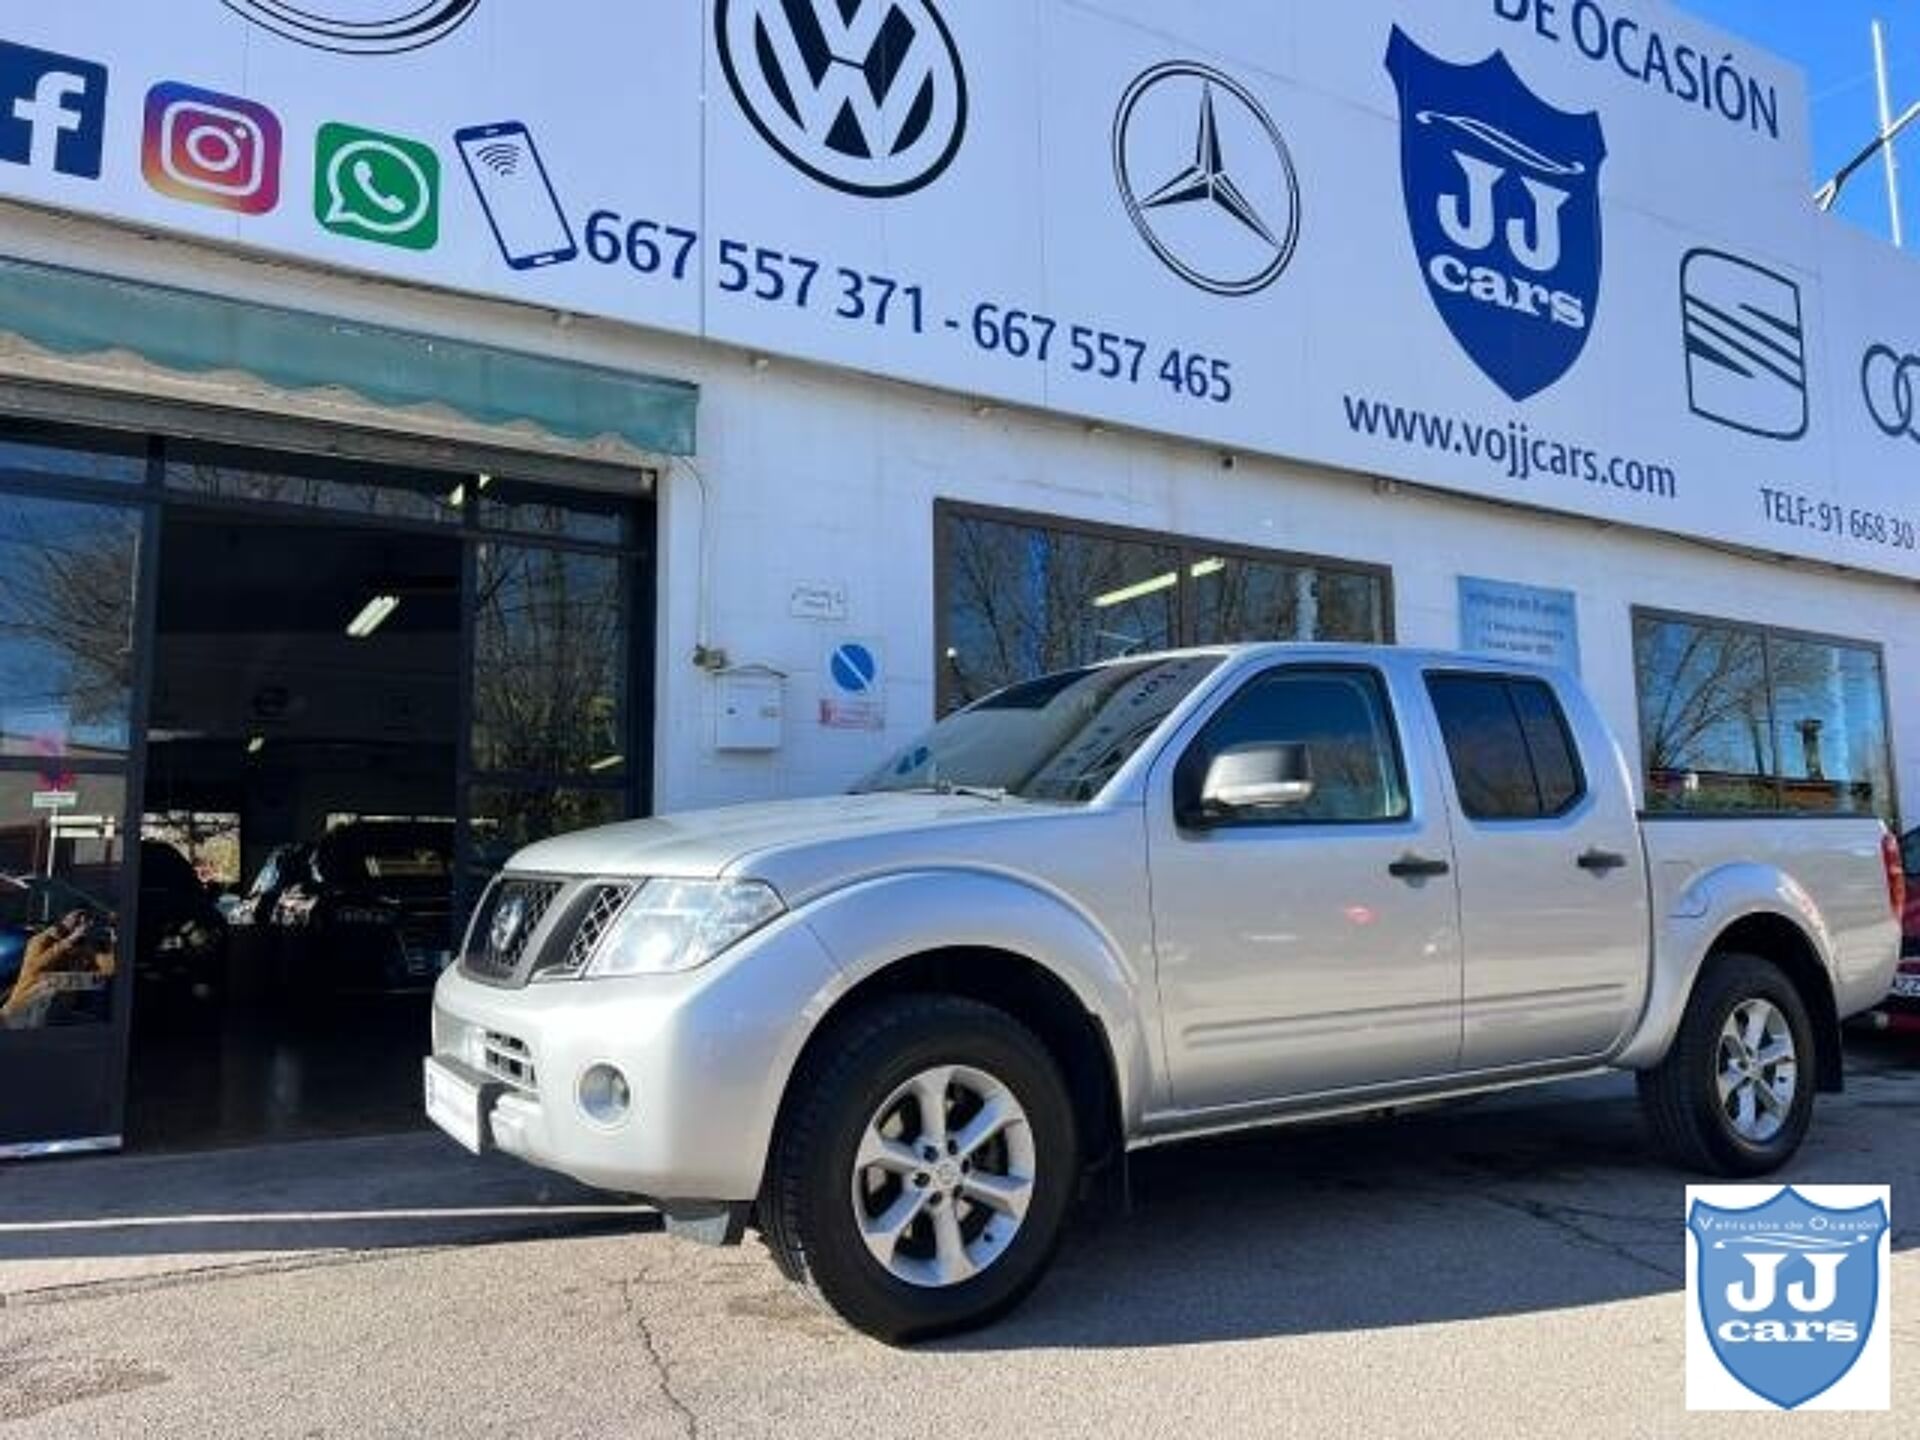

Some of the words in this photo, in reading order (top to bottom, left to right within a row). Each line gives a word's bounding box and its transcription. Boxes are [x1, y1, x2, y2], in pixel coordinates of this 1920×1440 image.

[1571, 0, 1779, 139] OCASIÓN
[1436, 149, 1570, 272] JJ
[584, 209, 698, 281] 667
[718, 238, 819, 308] 557
[836, 267, 923, 334] 371
[971, 302, 1057, 362] 667
[1070, 324, 1147, 384] 557
[1158, 348, 1232, 403] 465
[1429, 254, 1585, 329] cars
[1343, 395, 1676, 499] www.vojjcars.com
[1849, 509, 1888, 544] 668
[1889, 518, 1915, 550] 30
